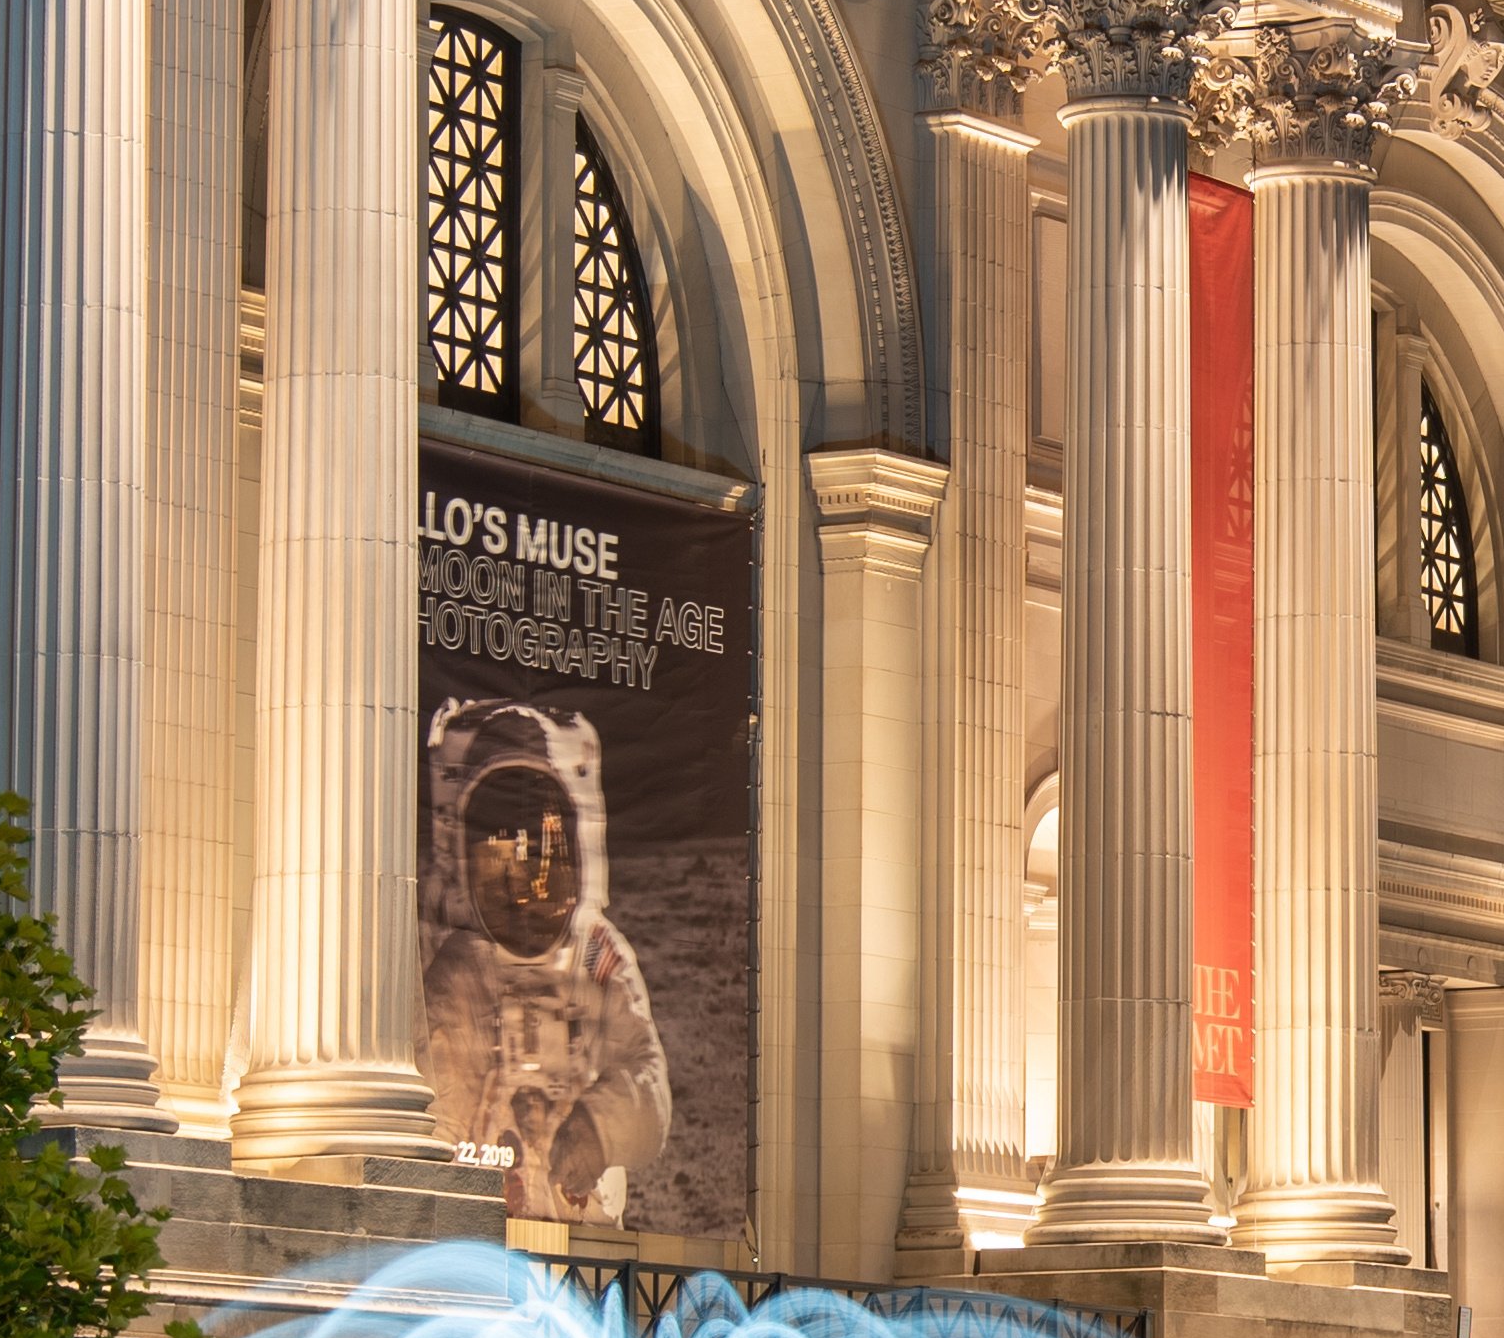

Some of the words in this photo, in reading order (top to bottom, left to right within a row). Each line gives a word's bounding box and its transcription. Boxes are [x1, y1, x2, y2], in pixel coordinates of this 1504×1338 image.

[418, 491, 508, 554] LO'S
[516, 514, 619, 580] MUSE
[418, 544, 525, 612] MOON
[533, 570, 570, 622] IN
[578, 579, 648, 639] THE
[655, 597, 725, 654] AGE
[418, 596, 659, 691] HOTOGRAPHY
[480, 1144, 515, 1168] 2019
